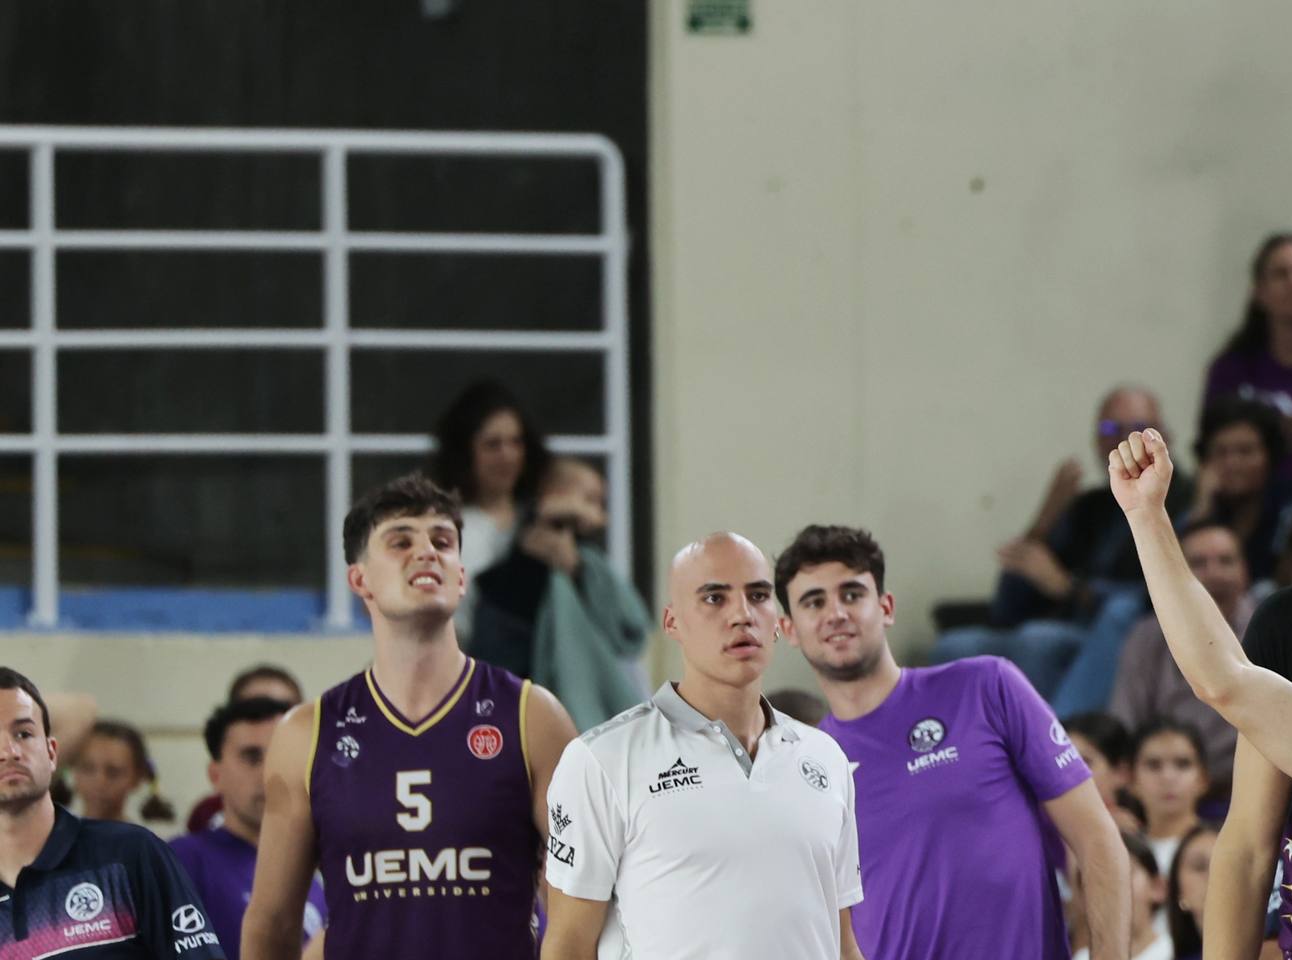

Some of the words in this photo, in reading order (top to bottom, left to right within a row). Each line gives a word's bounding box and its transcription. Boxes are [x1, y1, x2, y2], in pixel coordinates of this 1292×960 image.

[907, 746, 959, 772] UEMC
[658, 767, 700, 780] MERCURY
[649, 775, 703, 794] UEMC
[396, 770, 433, 832] 5
[345, 847, 493, 887] UEMC
[353, 886, 491, 902] UNIVERSIDAD
[63, 919, 112, 937] UEMC
